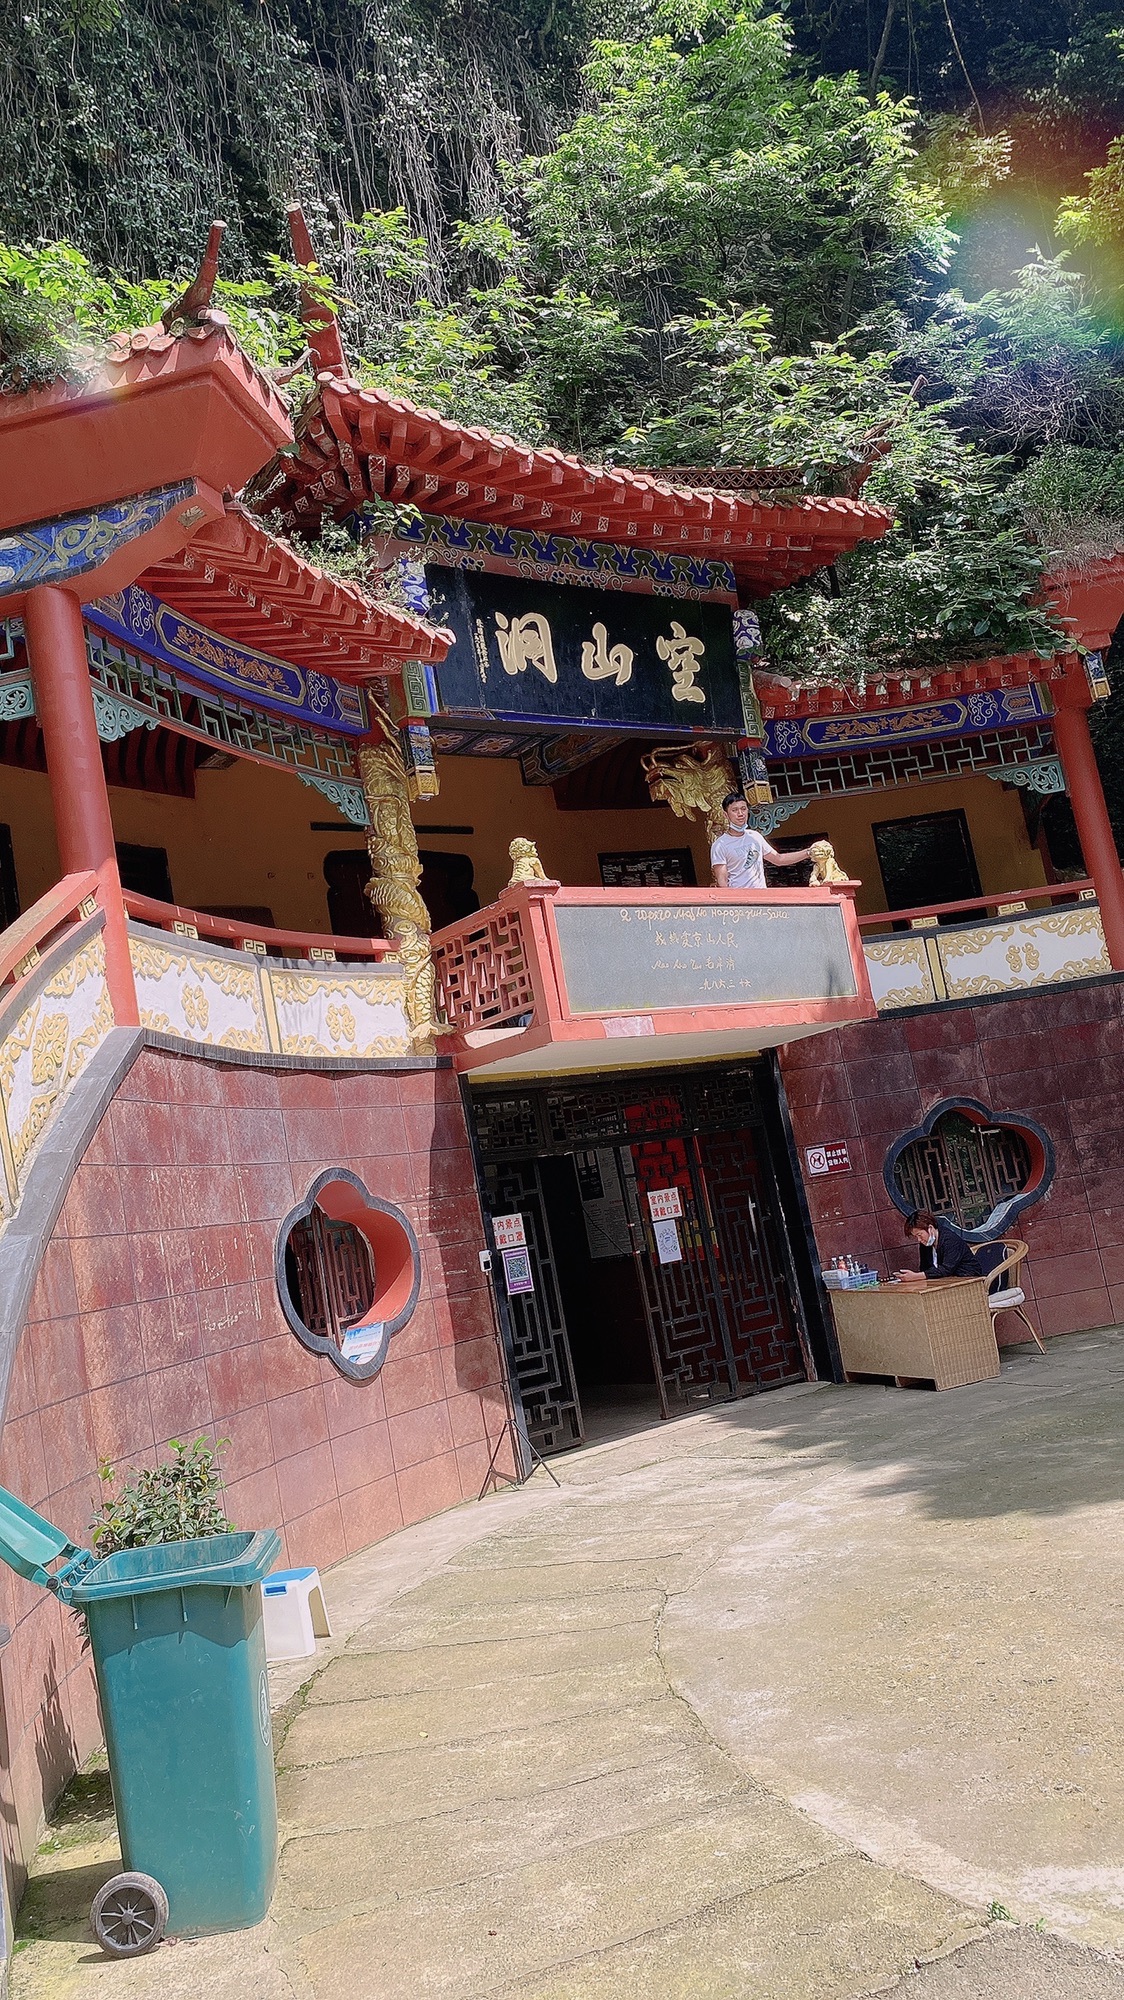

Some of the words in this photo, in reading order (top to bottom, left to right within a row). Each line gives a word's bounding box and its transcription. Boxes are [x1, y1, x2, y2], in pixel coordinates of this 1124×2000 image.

[494, 611, 706, 704] 空山洞
[650, 1191, 678, 1205] 室内景点
[653, 1203, 680, 1218] 请戴口罩
